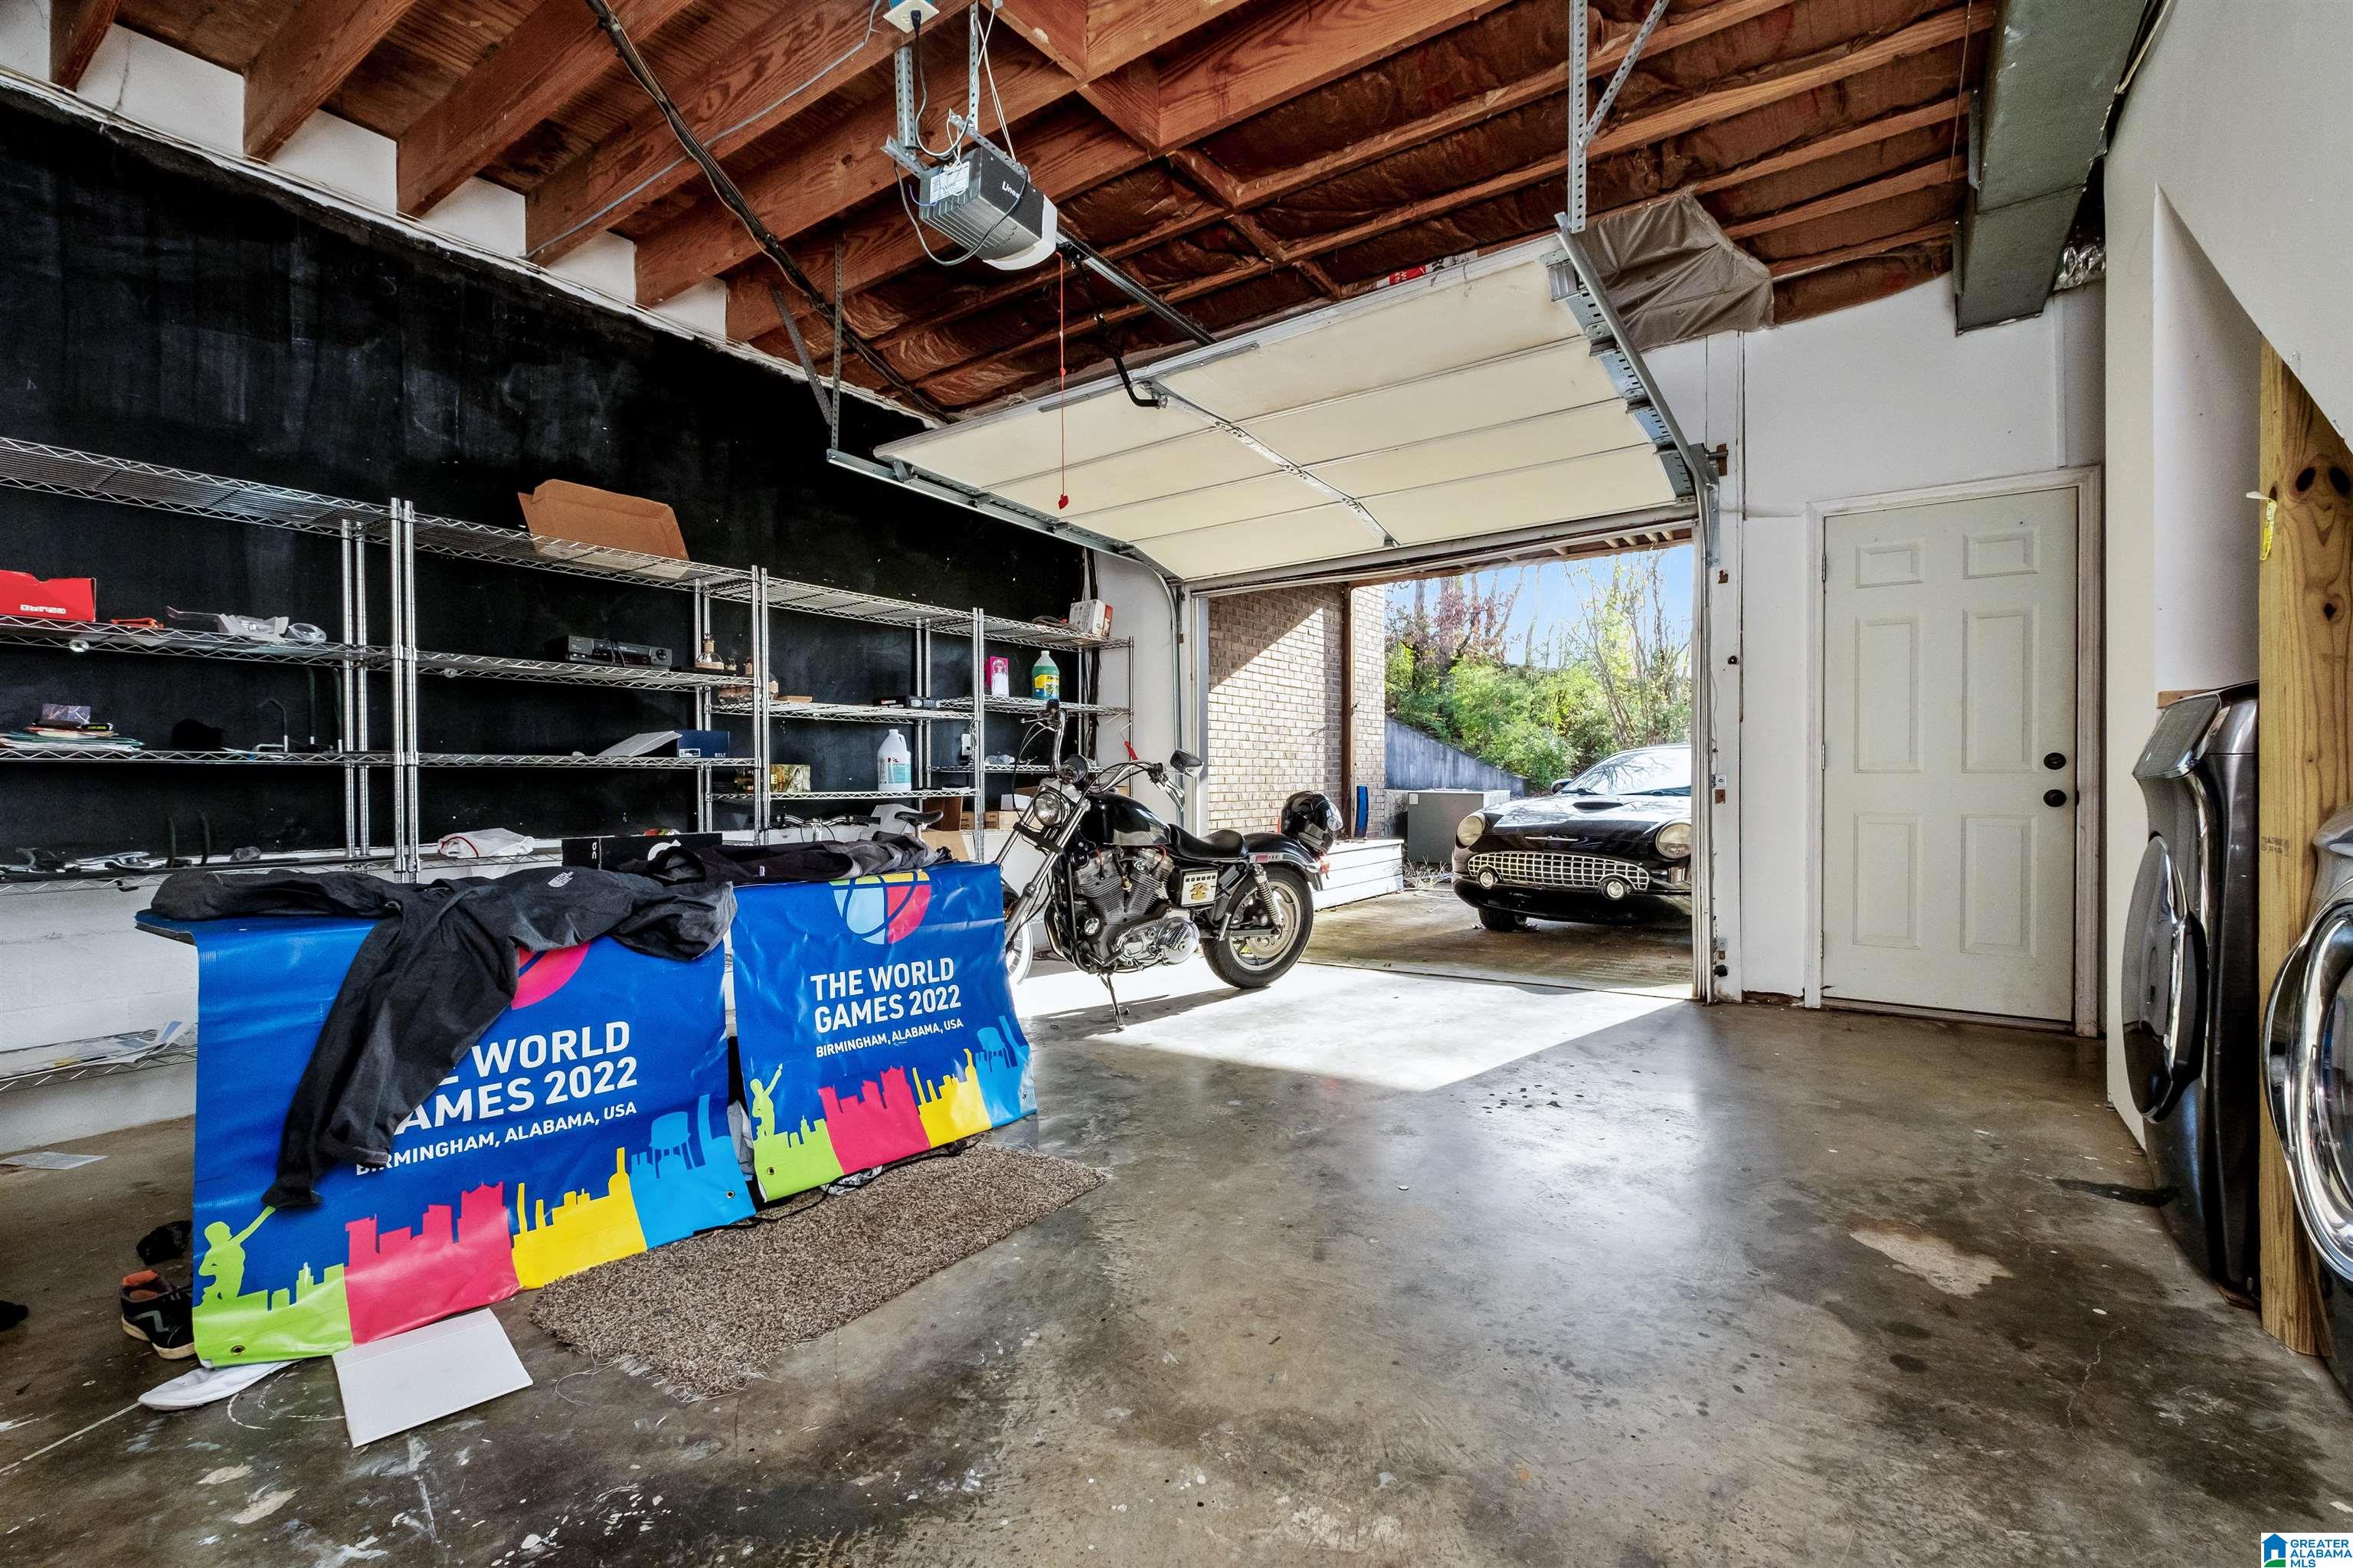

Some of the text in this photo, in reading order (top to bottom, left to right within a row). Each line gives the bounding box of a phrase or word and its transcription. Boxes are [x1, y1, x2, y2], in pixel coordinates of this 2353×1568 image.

[810, 957, 954, 1001] THE WORLD
[814, 984, 962, 1033] GAMES 2022
[471, 1020, 630, 1078] WORLD
[816, 1018, 964, 1058] BIRMINGHAM, ALABAMA, USA
[394, 1056, 638, 1135] AMES 2022
[504, 1111, 600, 1144] ALABAMA,
[604, 1102, 637, 1120] USA
